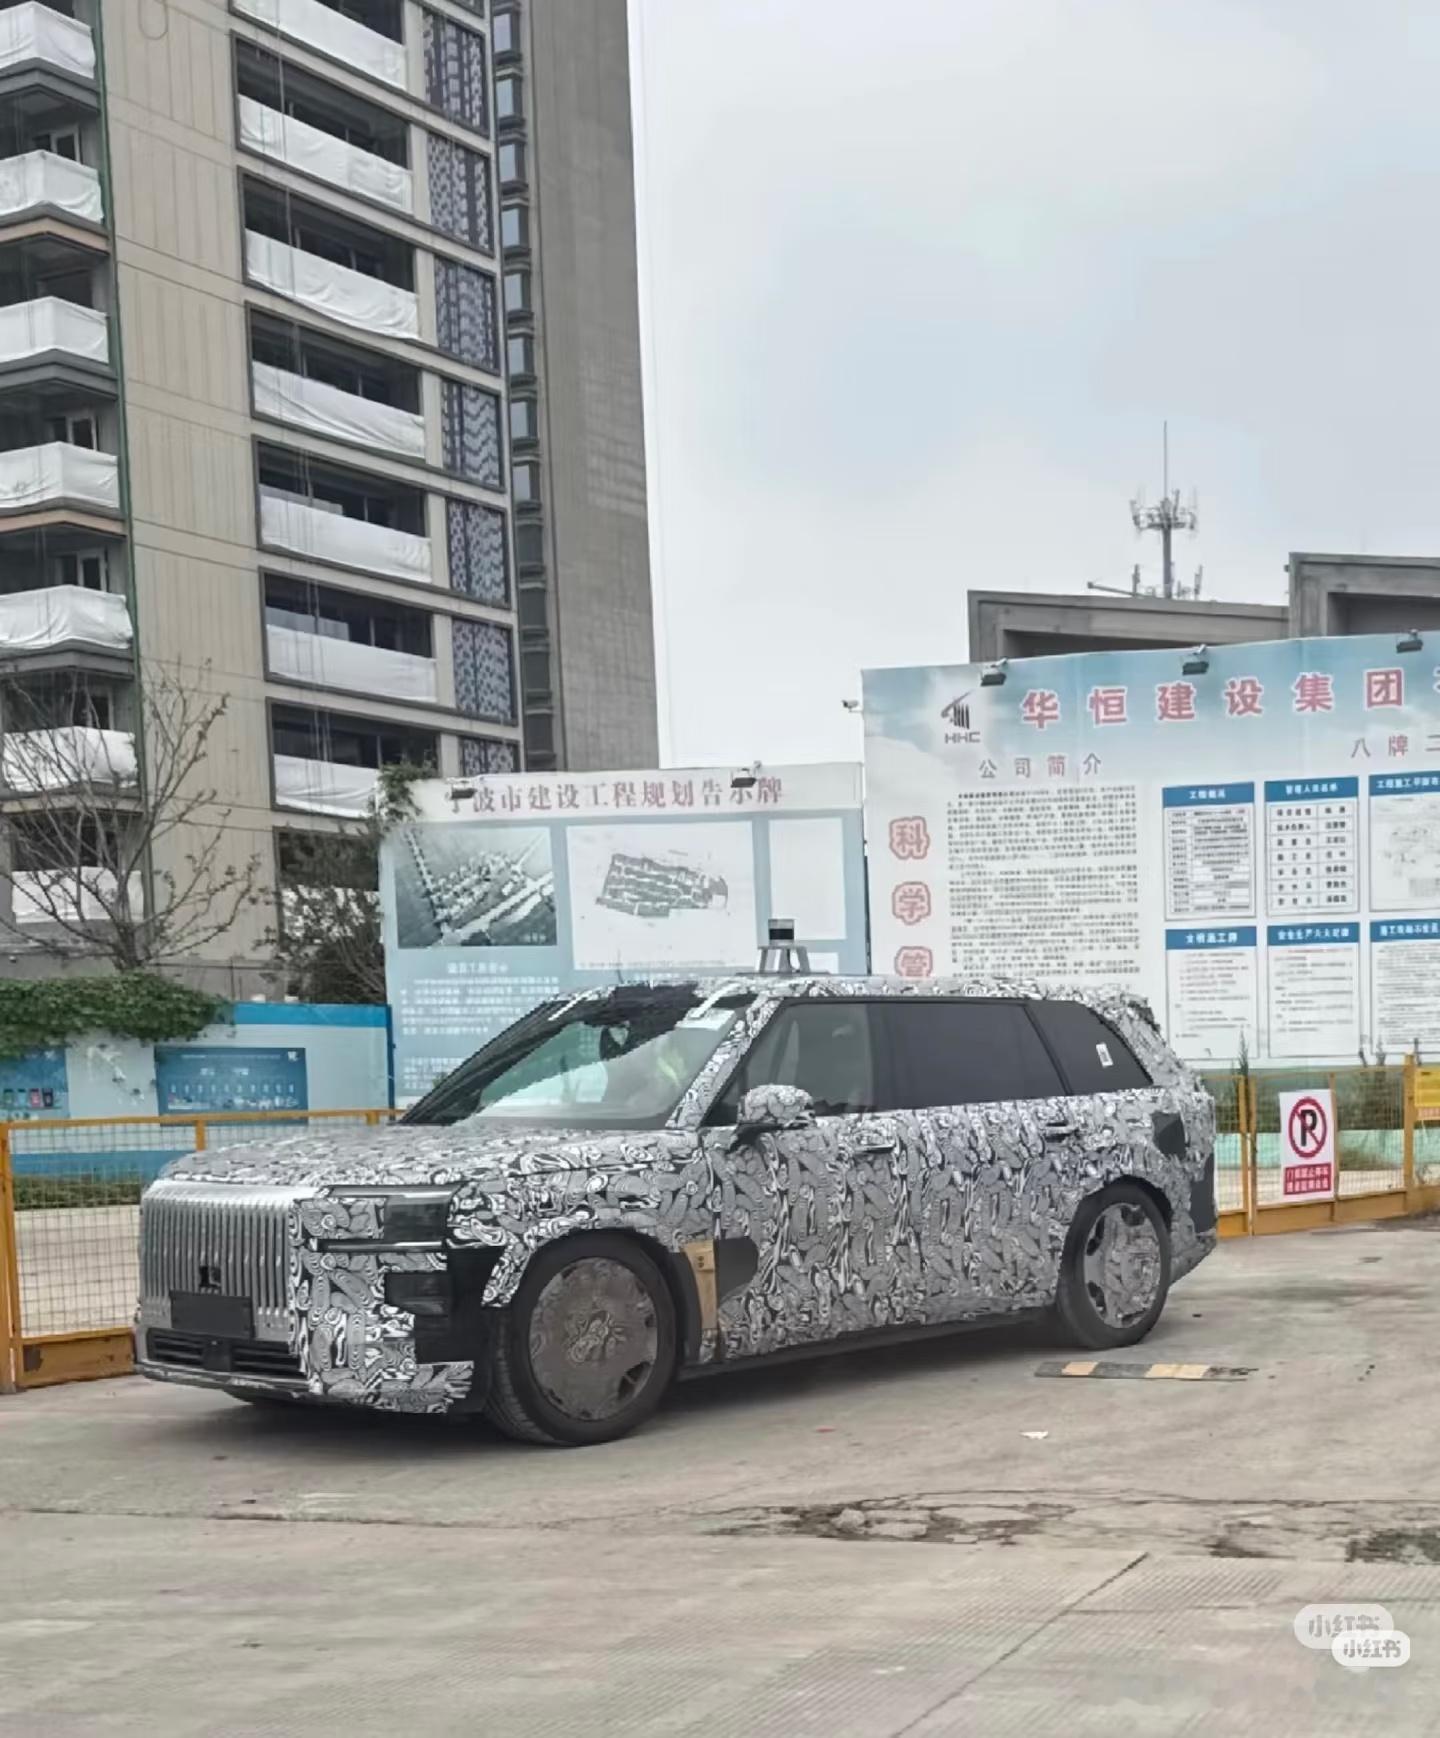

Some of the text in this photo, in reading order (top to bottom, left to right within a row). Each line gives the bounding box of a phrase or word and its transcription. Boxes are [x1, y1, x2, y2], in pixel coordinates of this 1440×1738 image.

[1020, 667, 1440, 730] 华恒建设集团
[944, 730, 981, 744] HHC
[979, 752, 1102, 779] 公司简介
